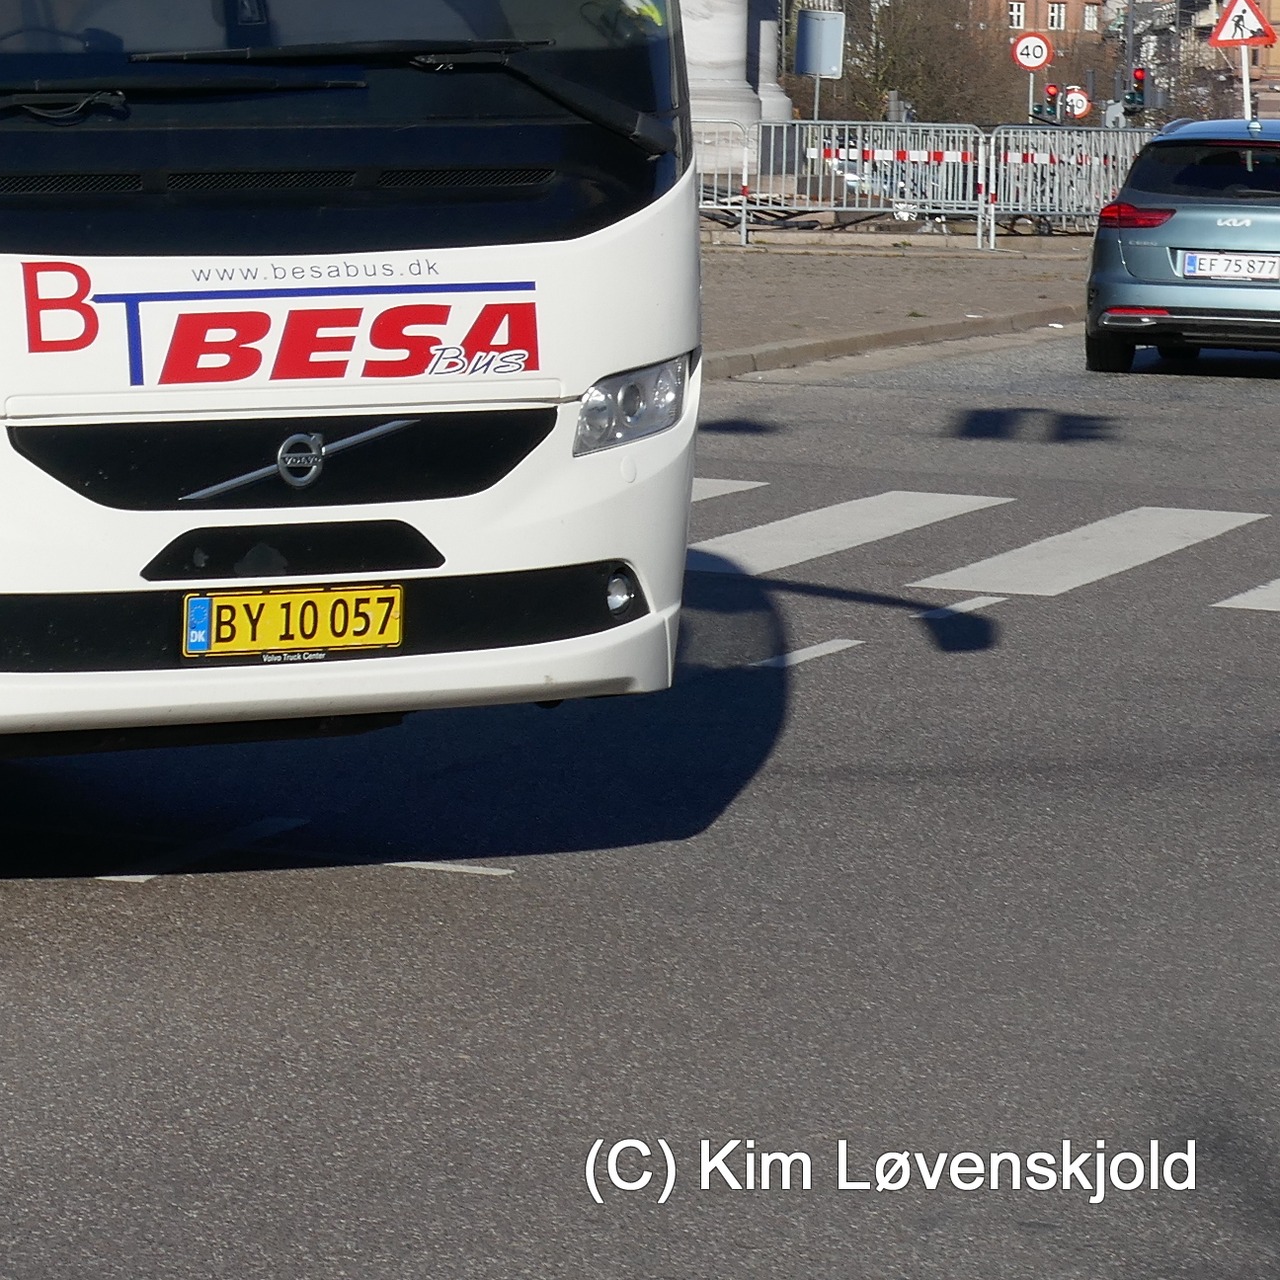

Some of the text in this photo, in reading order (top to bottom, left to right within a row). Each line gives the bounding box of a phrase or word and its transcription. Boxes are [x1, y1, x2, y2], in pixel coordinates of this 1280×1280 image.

[1020, 45, 1044, 59] 40
[192, 258, 440, 282] www.besabus.dk
[1198, 257, 1277, 274] EF 75 877
[157, 302, 540, 386] BESA
[427, 346, 529, 376] Bus
[190, 597, 395, 644] DK BY 10 057
[262, 651, 326, 663] Volvo Truck Center
